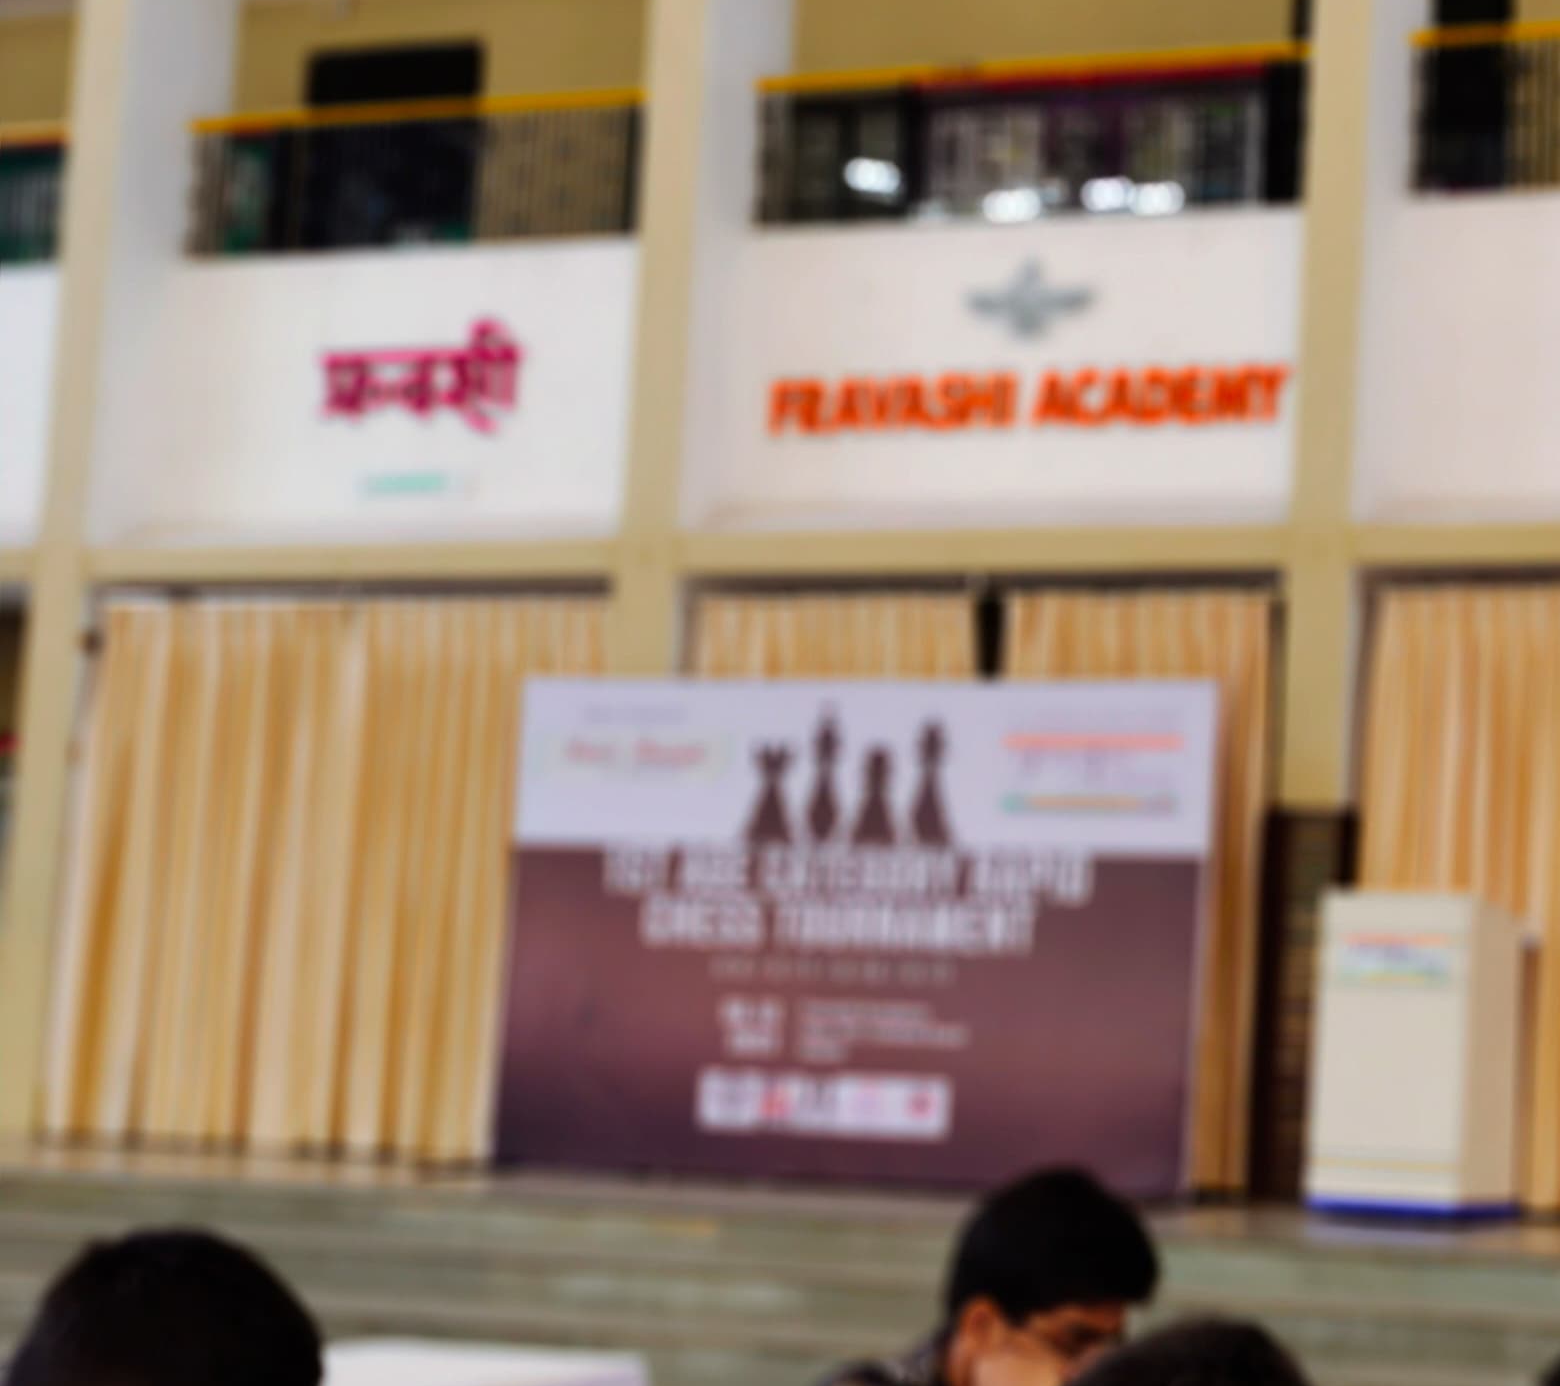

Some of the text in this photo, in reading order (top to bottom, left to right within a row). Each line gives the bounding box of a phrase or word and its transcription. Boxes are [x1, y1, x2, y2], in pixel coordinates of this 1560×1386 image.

[1030, 362, 1287, 427] ACADEMY
[639, 894, 1035, 956] CHESS TOURNAMENT
